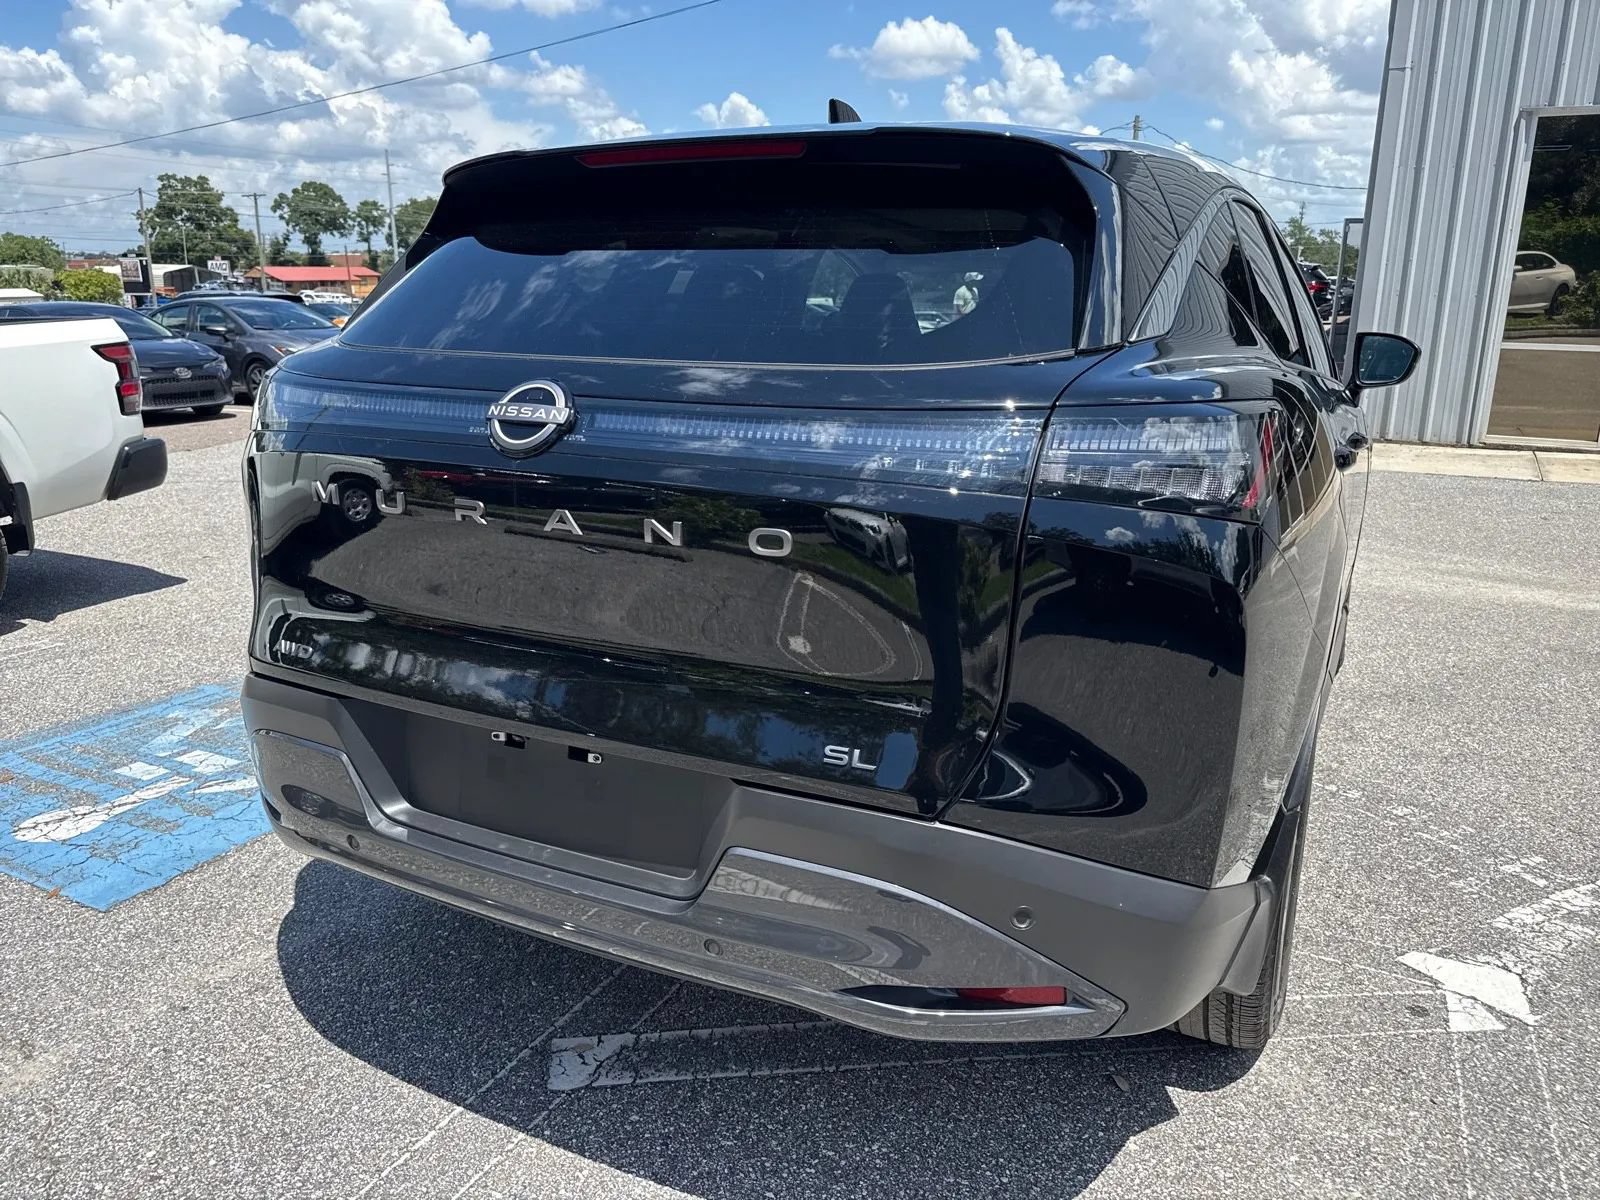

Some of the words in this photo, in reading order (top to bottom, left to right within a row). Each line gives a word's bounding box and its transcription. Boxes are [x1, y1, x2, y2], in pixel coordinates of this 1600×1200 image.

[488, 405, 569, 421] NISSAN
[312, 480, 793, 557] MURANO
[273, 640, 313, 659] AWD
[823, 745, 877, 771] SL
